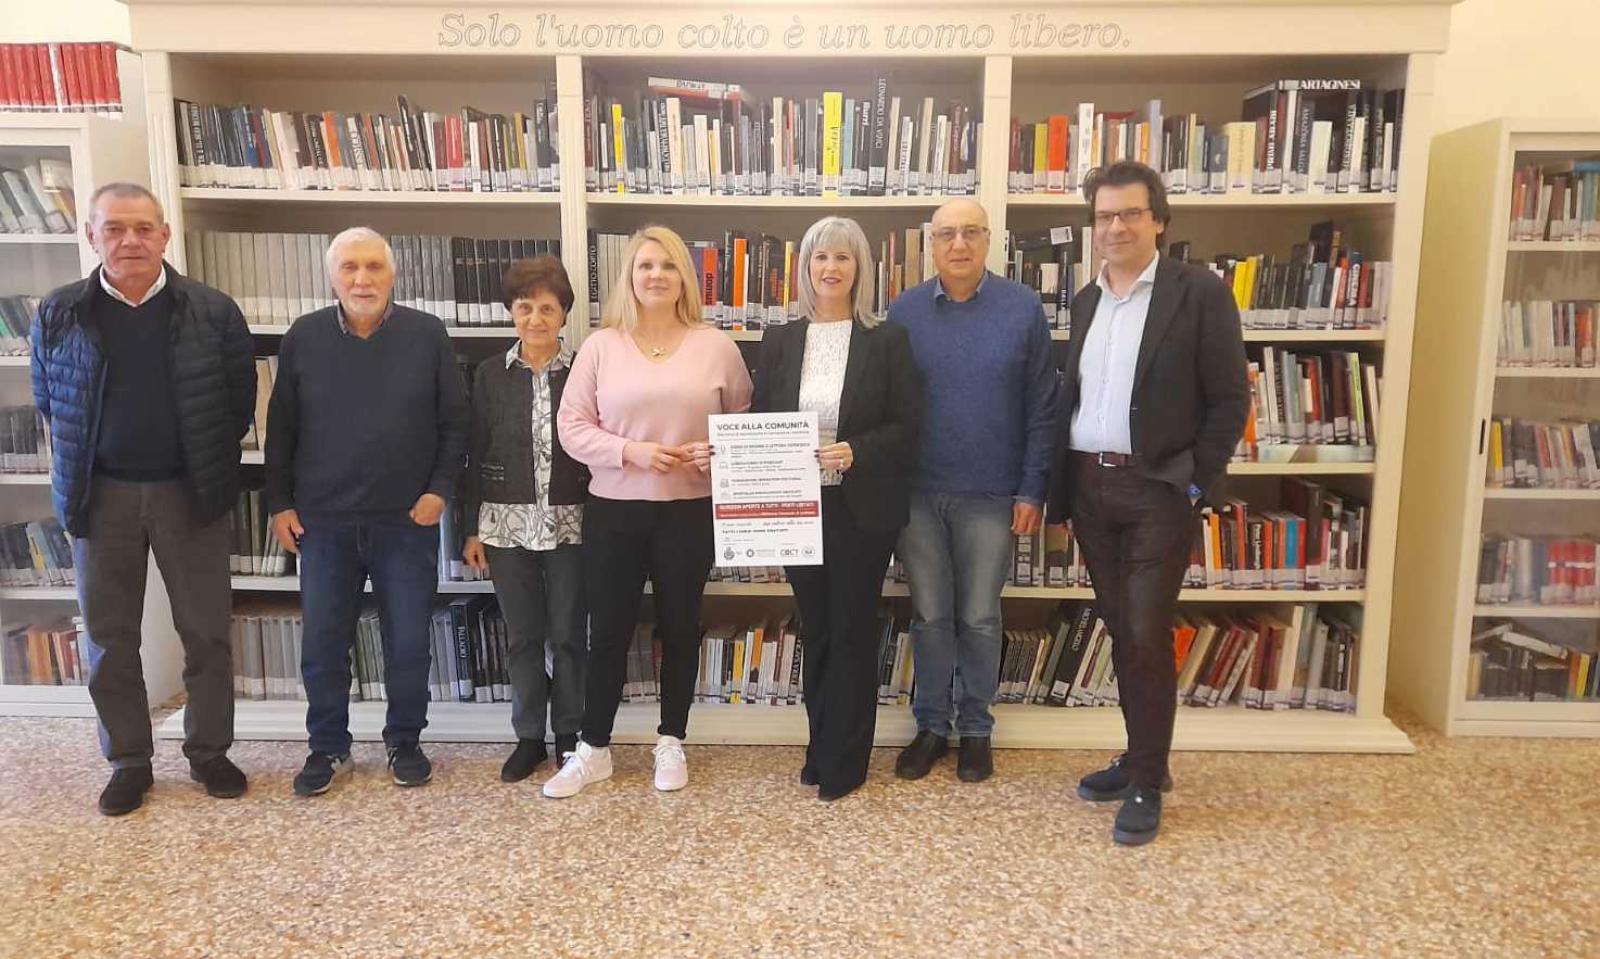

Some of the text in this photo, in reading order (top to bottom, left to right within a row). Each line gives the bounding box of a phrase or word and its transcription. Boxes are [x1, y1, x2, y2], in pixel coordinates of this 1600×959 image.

[439, 13, 1130, 49] Solo l'uomo colto è un uomo libero.
[877, 78, 886, 115] LEONARDO
[1298, 80, 1360, 90] ARTAGINESI
[874, 128, 884, 149] VINCI
[705, 273, 714, 305] domus
[717, 419, 809, 431] VOCE ALLA COMUNITÀ
